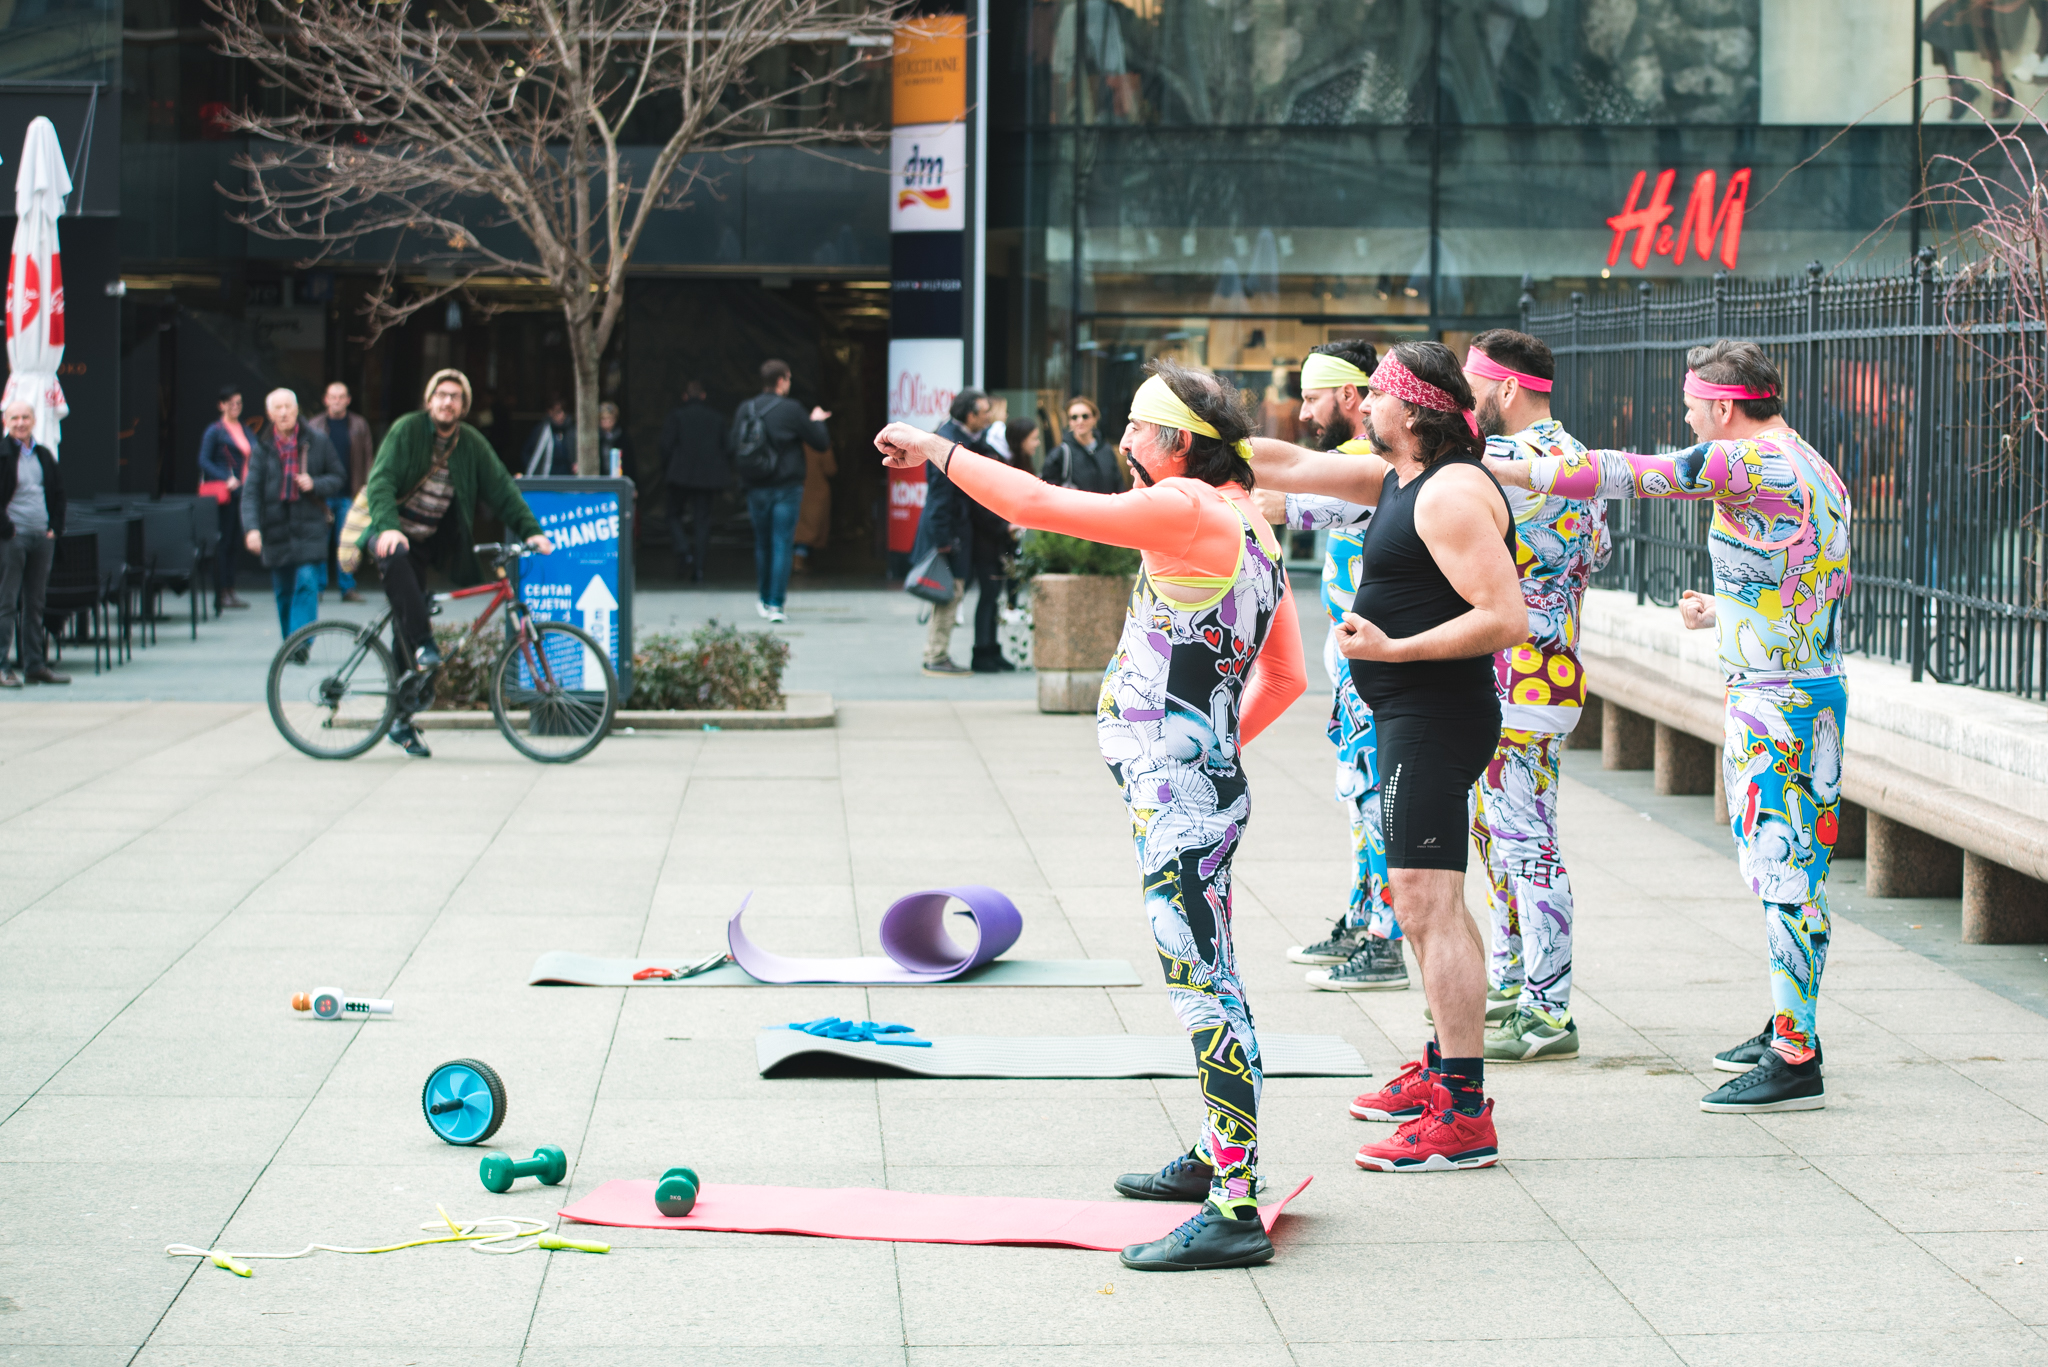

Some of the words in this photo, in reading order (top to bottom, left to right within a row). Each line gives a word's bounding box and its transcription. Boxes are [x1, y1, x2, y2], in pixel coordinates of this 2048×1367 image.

[903, 144, 944, 187] dm
[1605, 167, 1752, 270] H&M
[524, 584, 572, 597] CENTAR
